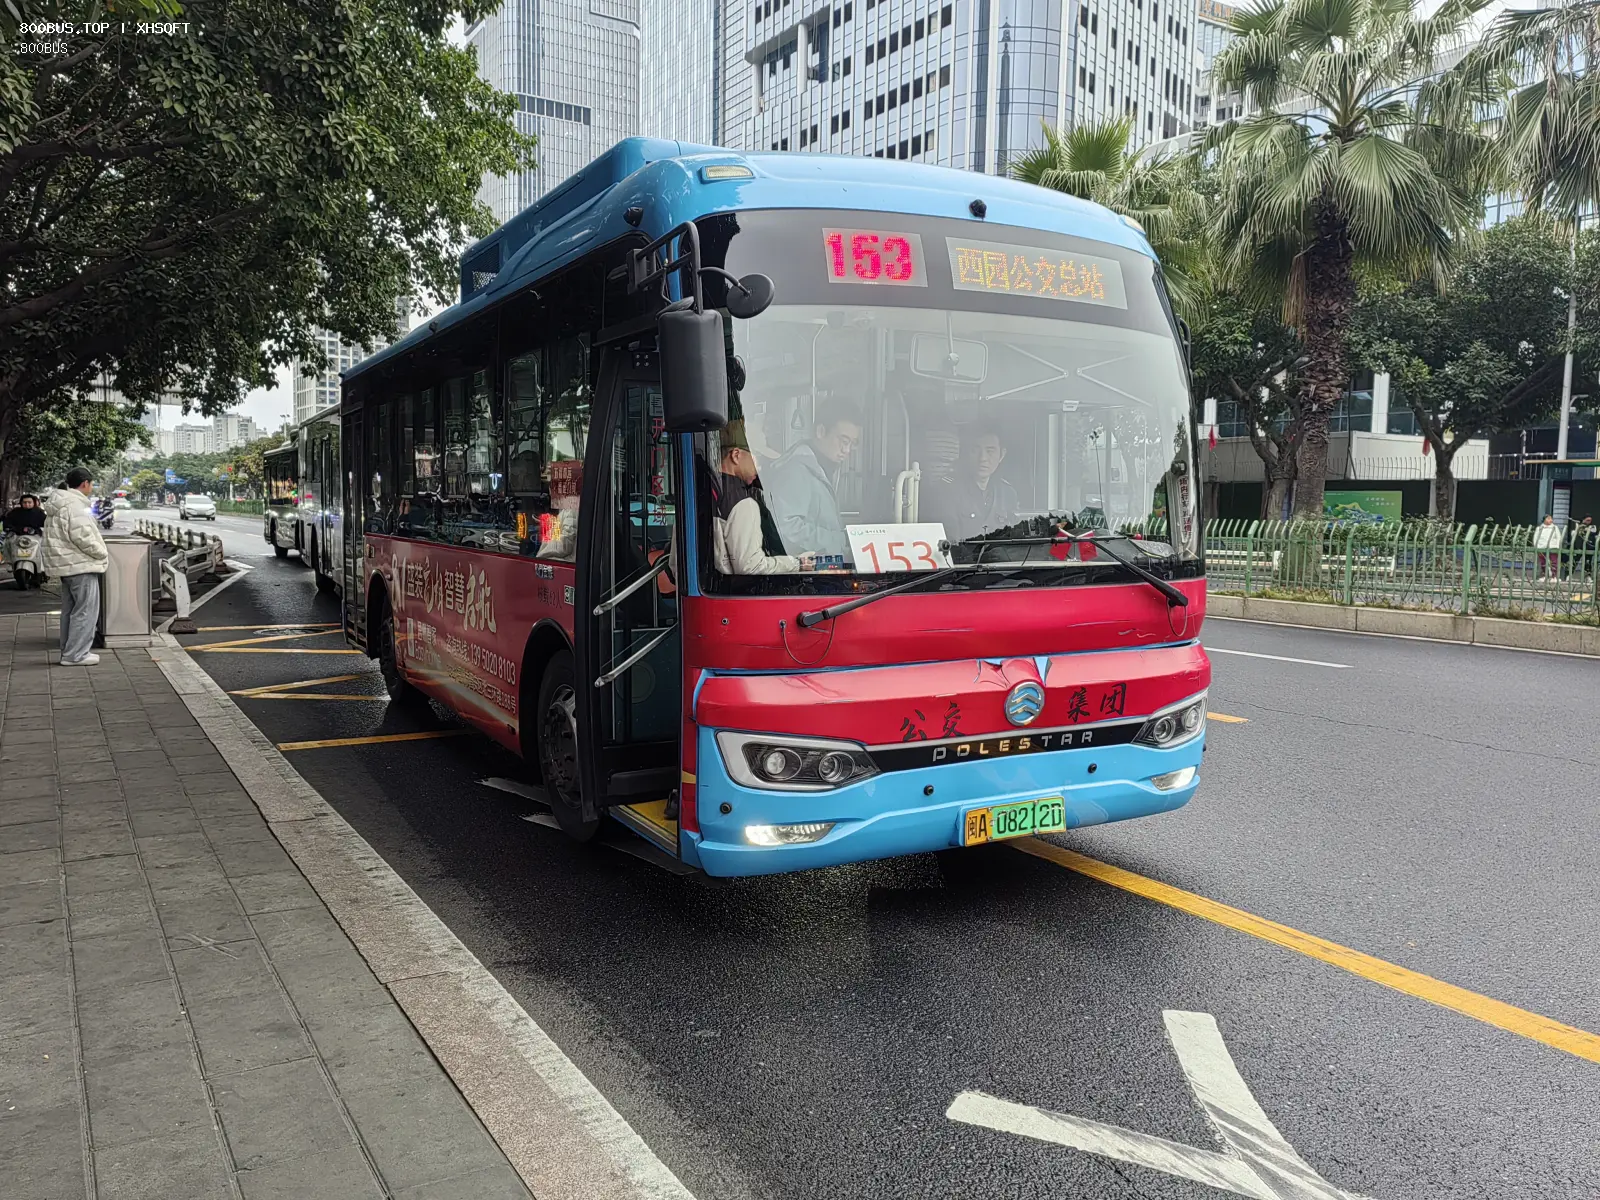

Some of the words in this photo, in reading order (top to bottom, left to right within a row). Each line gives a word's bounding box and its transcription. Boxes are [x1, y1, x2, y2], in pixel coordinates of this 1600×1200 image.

[826, 232, 912, 281] 153
[861, 541, 938, 574] 153
[471, 643, 481, 667] 139
[482, 649, 498, 676] 5020
[498, 657, 516, 685] 8103
[900, 701, 965, 742] 公交
[1067, 682, 1127, 722] 集团
[933, 731, 1093, 762] POLESTAR
